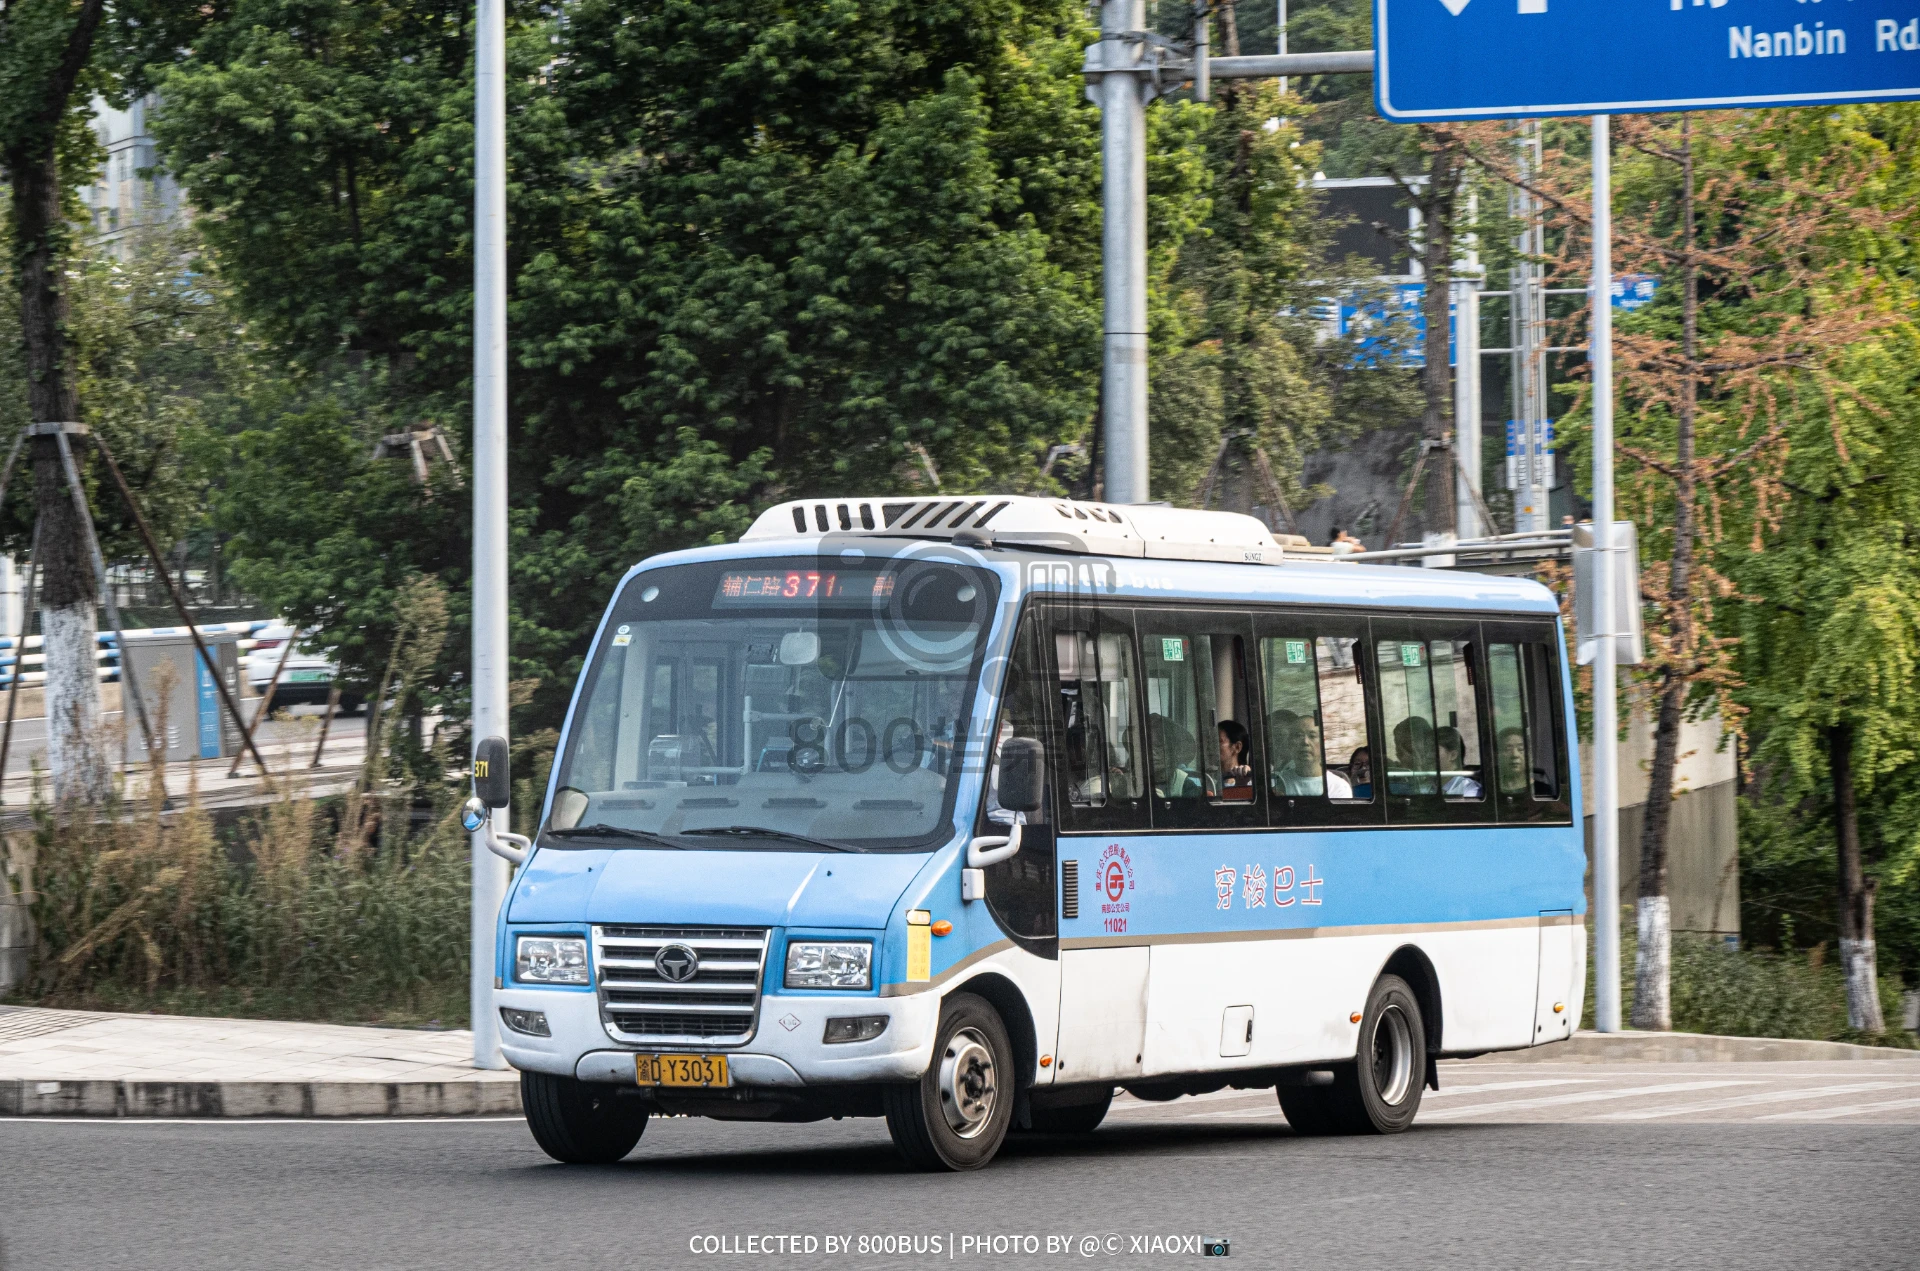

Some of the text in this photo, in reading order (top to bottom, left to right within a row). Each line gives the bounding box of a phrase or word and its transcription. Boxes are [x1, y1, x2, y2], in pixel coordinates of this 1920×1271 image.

[1729, 21, 1847, 59] Nanbin
[783, 572, 836, 598] 371
[475, 761, 489, 778] 371
[1214, 864, 1324, 909] 穿梭巴士
[1104, 918, 1127, 933] 11021
